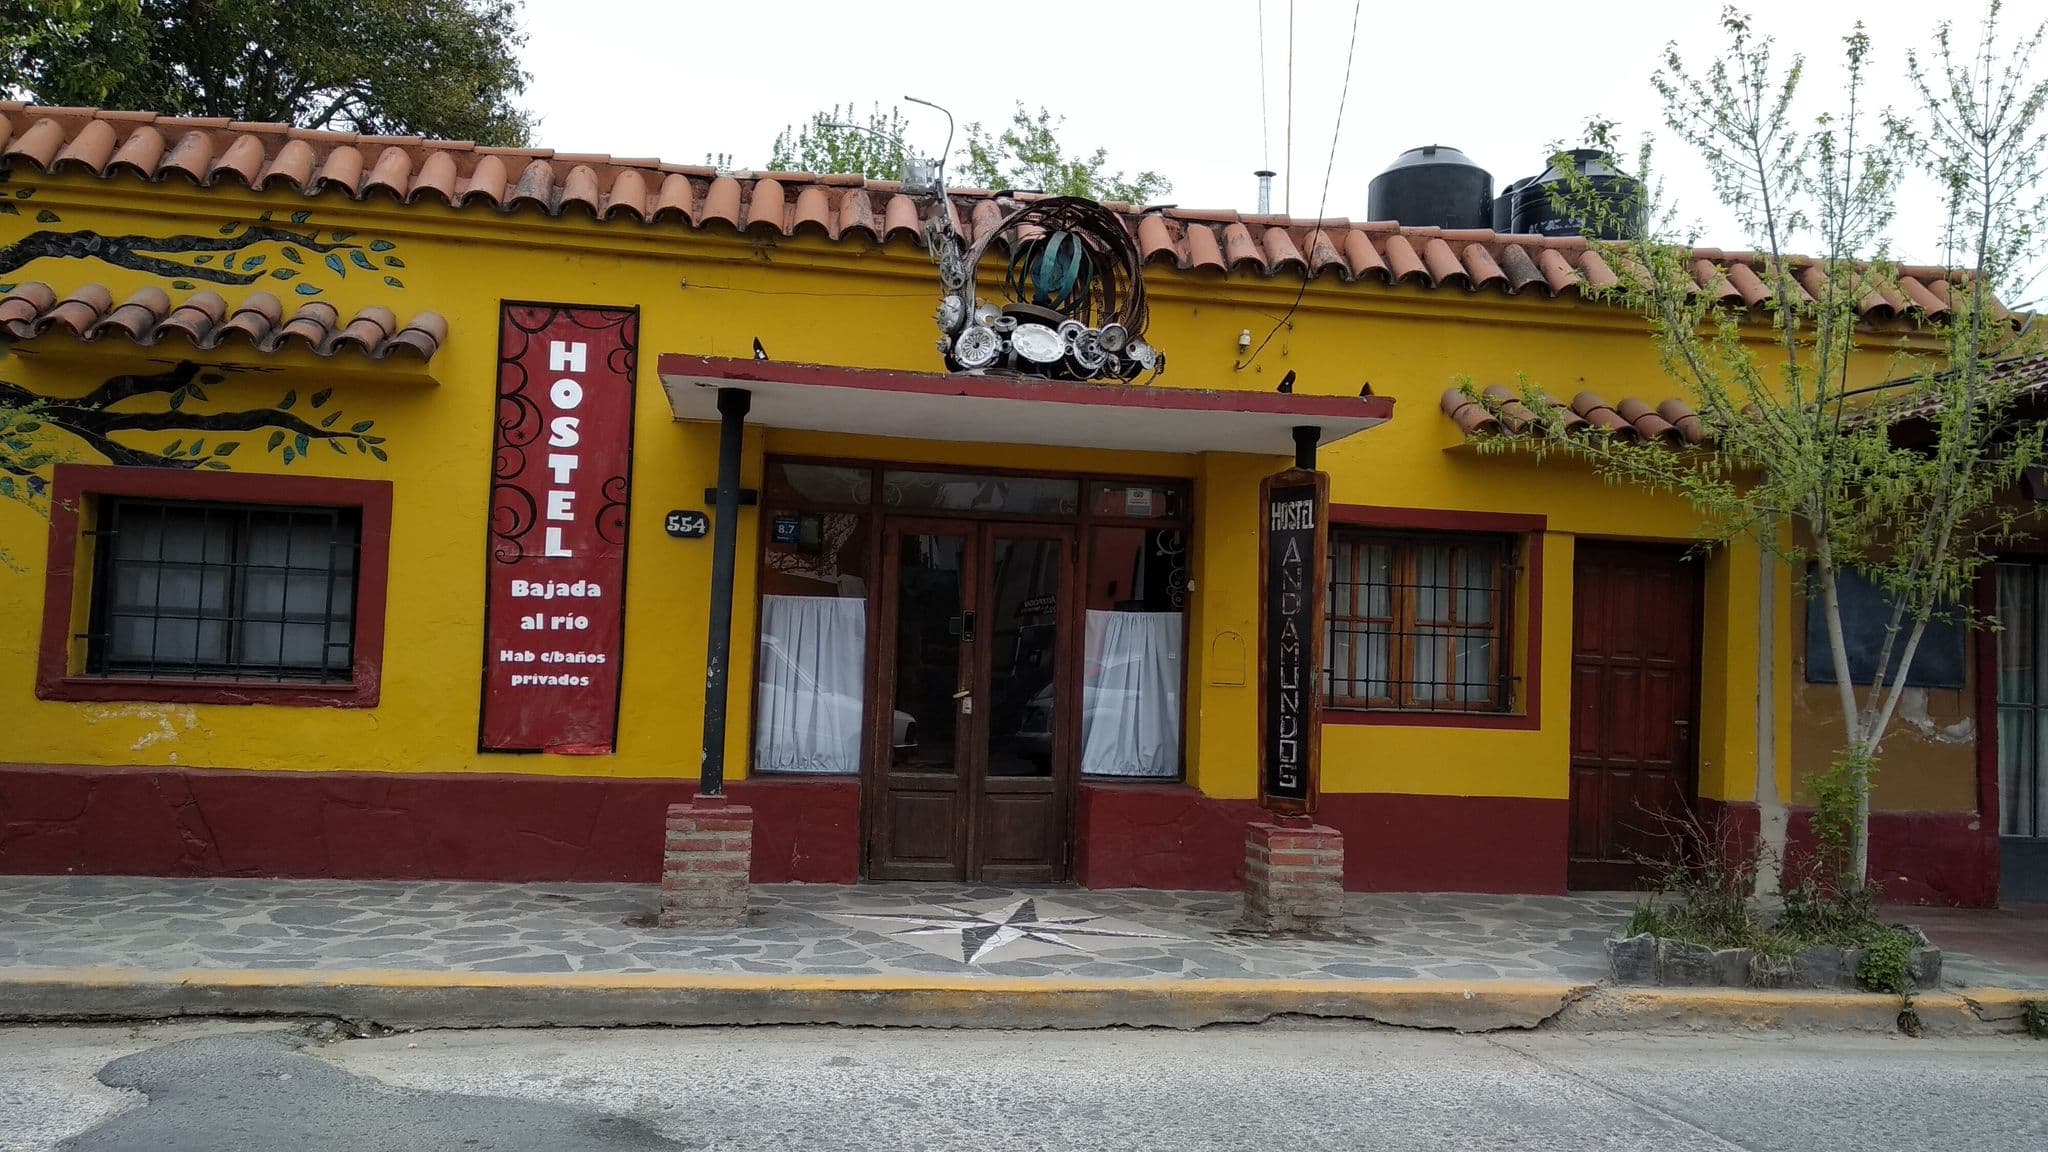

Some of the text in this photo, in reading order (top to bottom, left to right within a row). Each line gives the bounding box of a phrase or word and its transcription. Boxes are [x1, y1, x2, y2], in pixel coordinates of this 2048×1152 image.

[544, 340, 588, 558] HOSTEL
[667, 515, 706, 534] 554
[1271, 499, 1315, 531] HOSTEL
[511, 579, 602, 600] Bajada
[520, 612, 589, 630] al río
[499, 649, 606, 664] Hab c/baños
[1279, 536, 1302, 789] ANDAMUNDOS
[511, 673, 590, 687] privados
